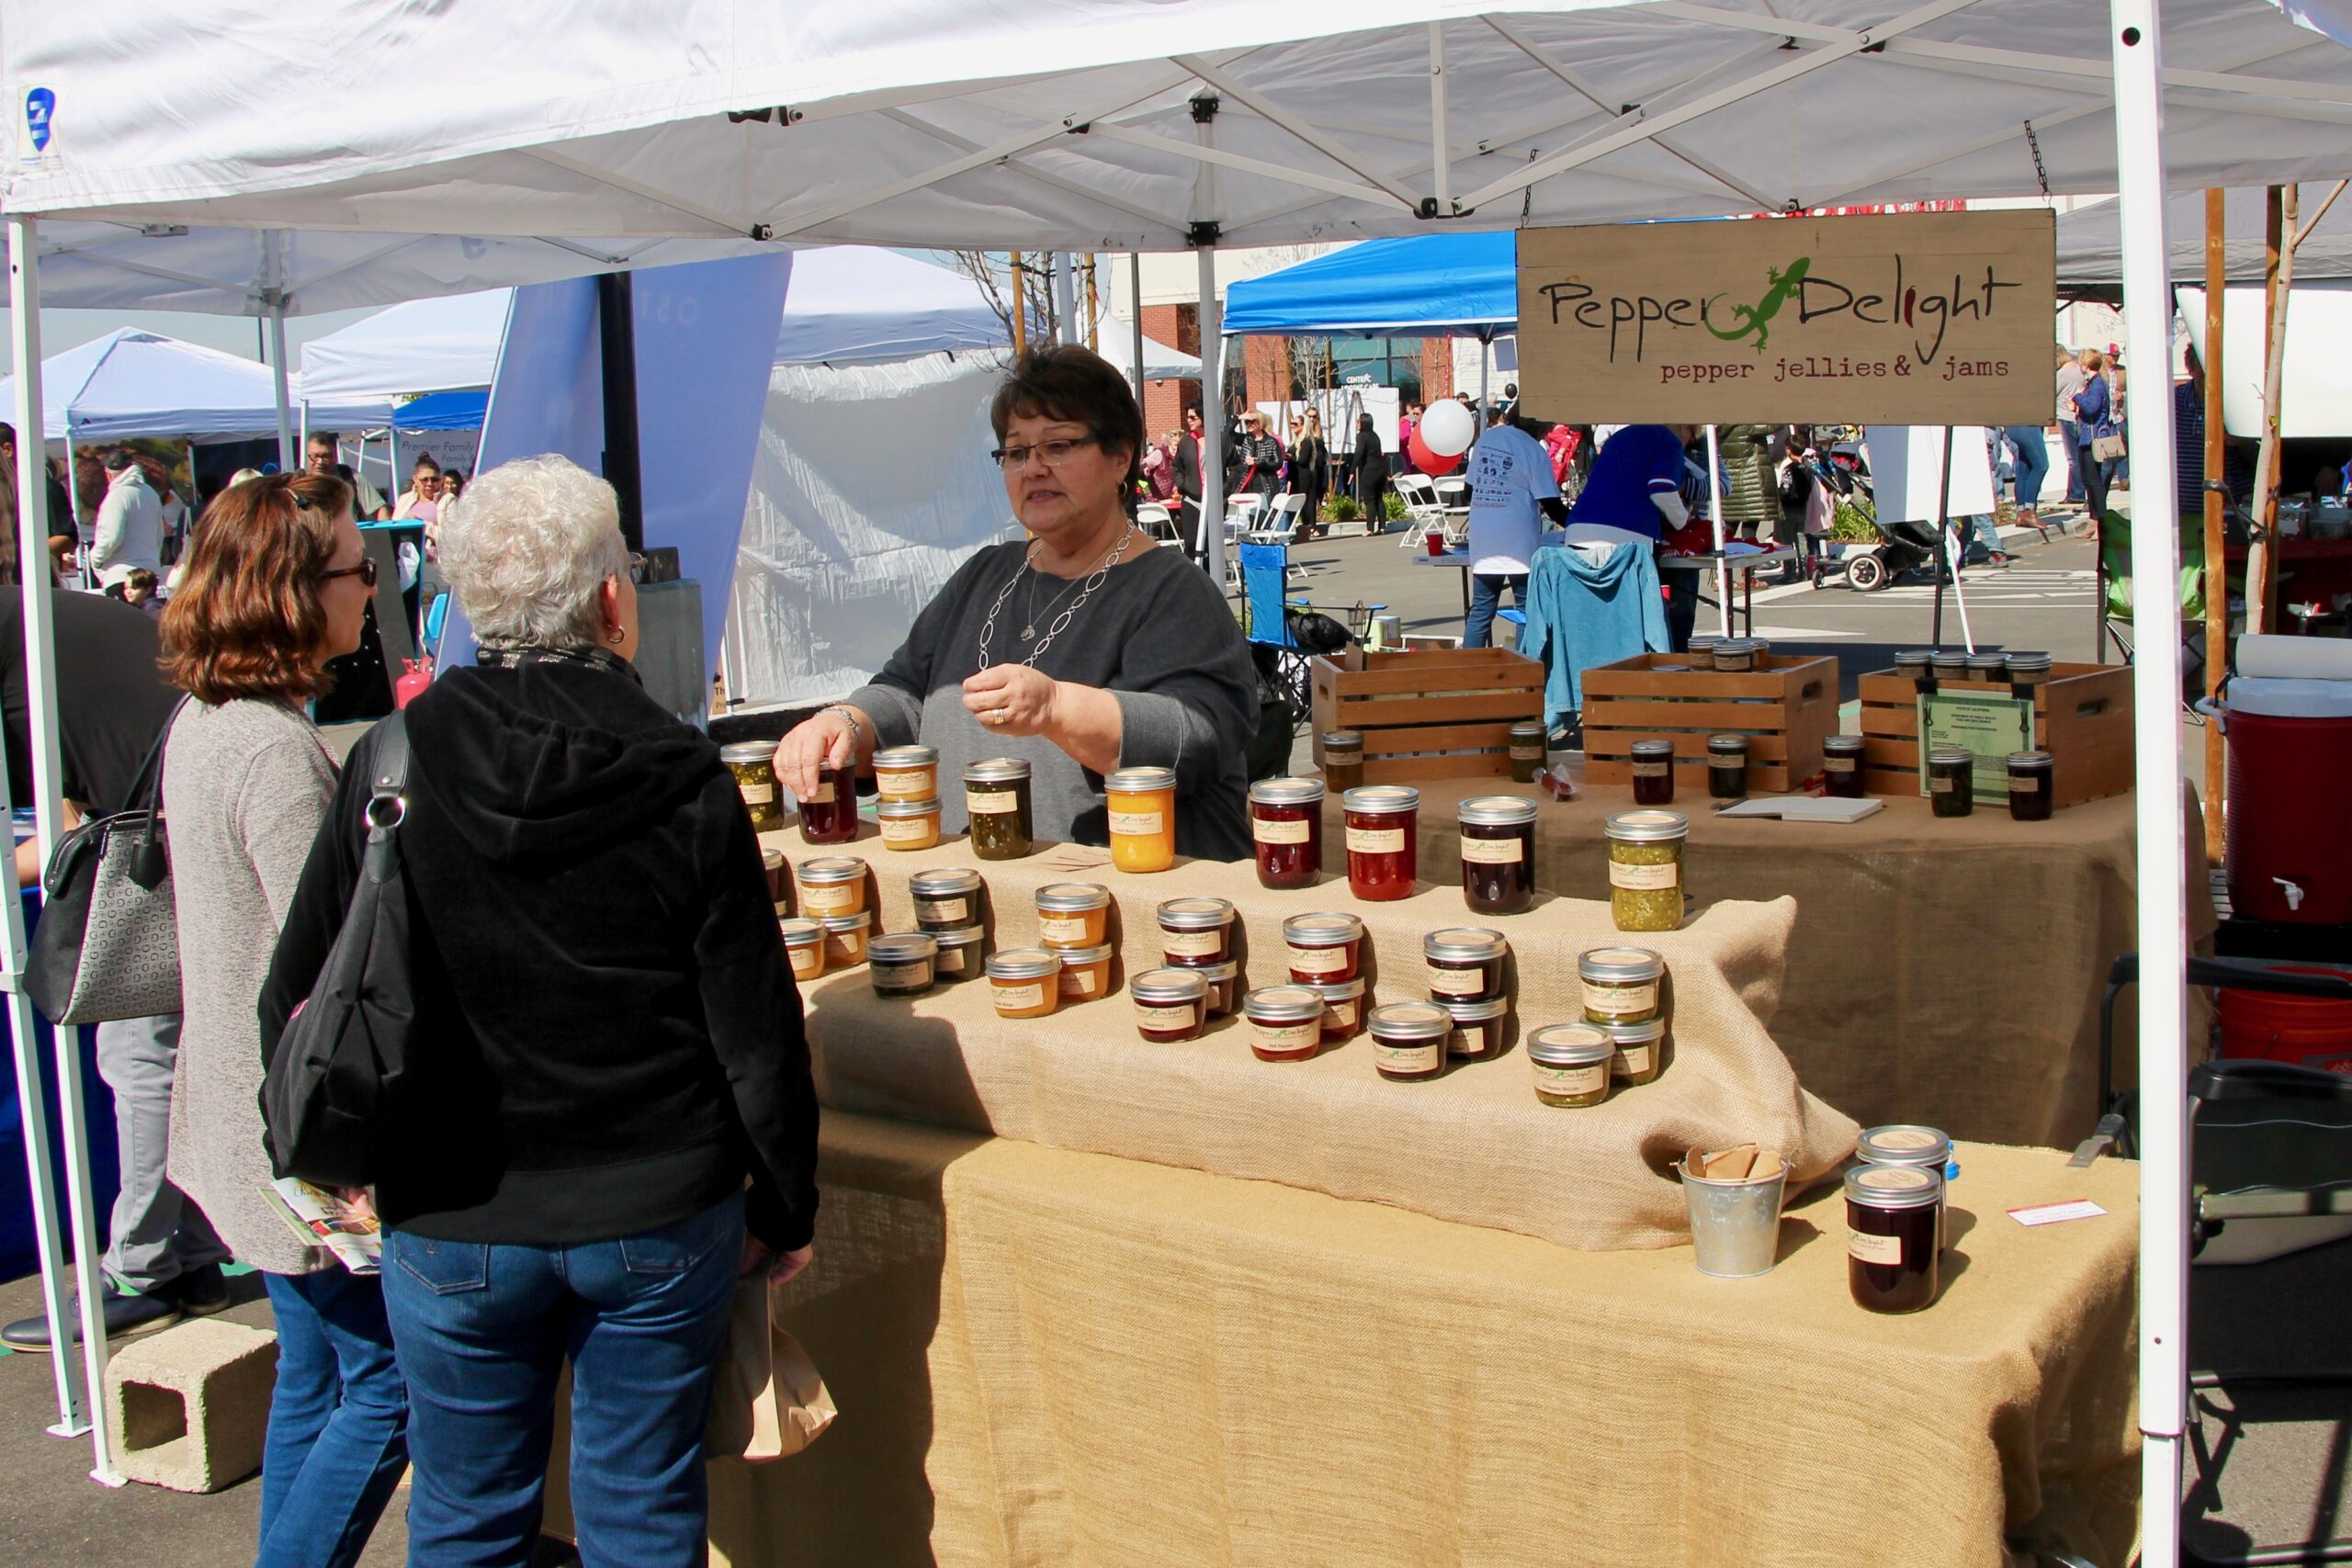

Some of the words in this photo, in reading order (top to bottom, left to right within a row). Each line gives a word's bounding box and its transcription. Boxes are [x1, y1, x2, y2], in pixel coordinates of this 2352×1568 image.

[1539, 282, 1730, 363] Pepper
[1798, 254, 2023, 366] Delight
[1660, 362, 1756, 385] pepper
[1773, 356, 1887, 383] jellies
[1894, 357, 1911, 378] &
[1941, 356, 2009, 382] jams
[401, 440, 441, 452] Premier
[443, 441, 474, 454] Family
